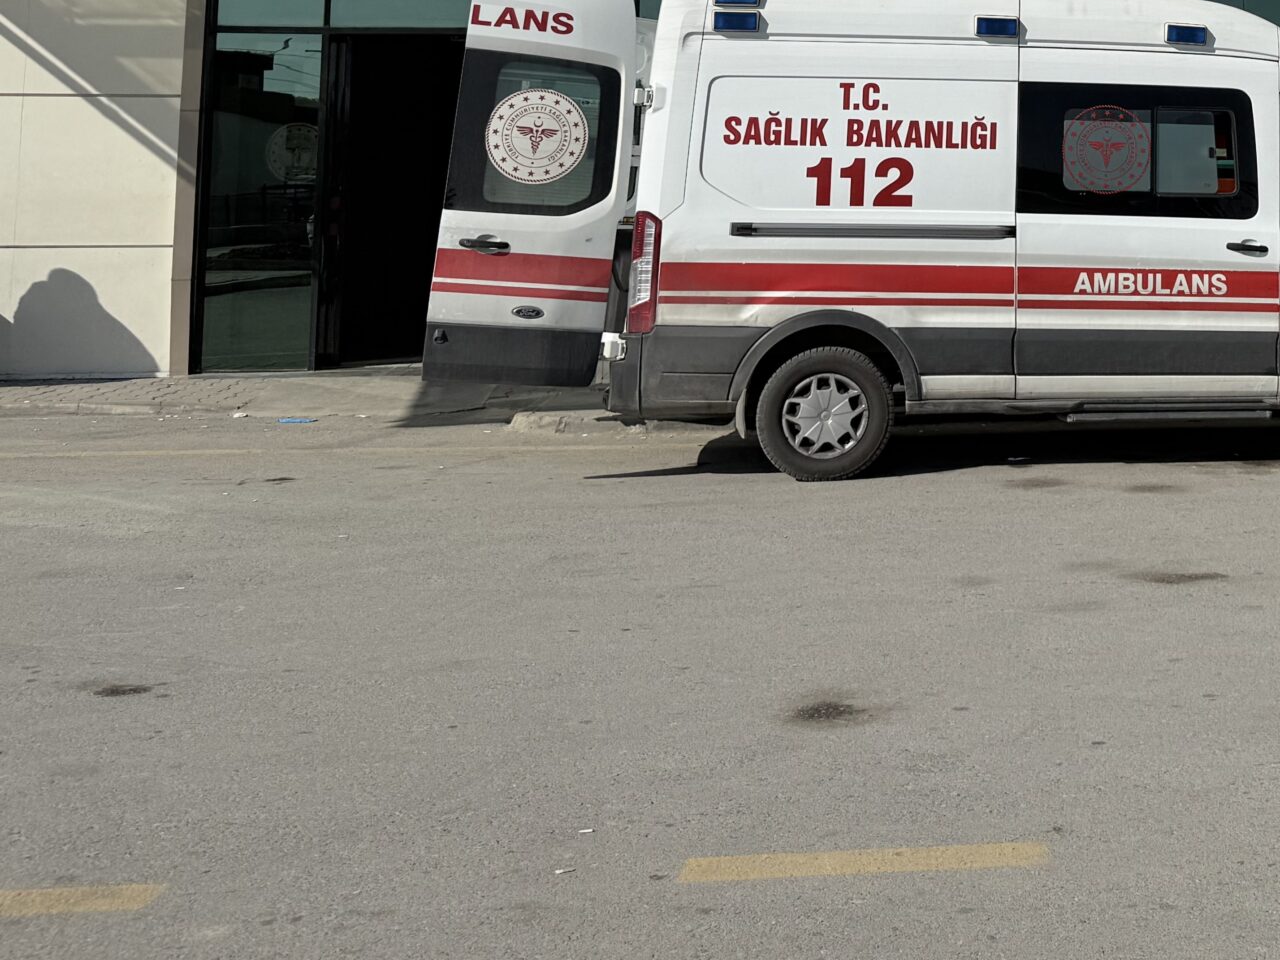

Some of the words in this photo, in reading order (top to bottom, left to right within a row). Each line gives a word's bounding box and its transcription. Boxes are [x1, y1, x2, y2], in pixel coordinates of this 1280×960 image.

[471, 4, 575, 35] LANS
[839, 82, 889, 111] T.C.
[722, 110, 829, 147] SAĞLIK
[845, 115, 998, 150] BAKANLIĞI
[806, 157, 915, 207] 112
[1073, 271, 1229, 296] AMBULANS
